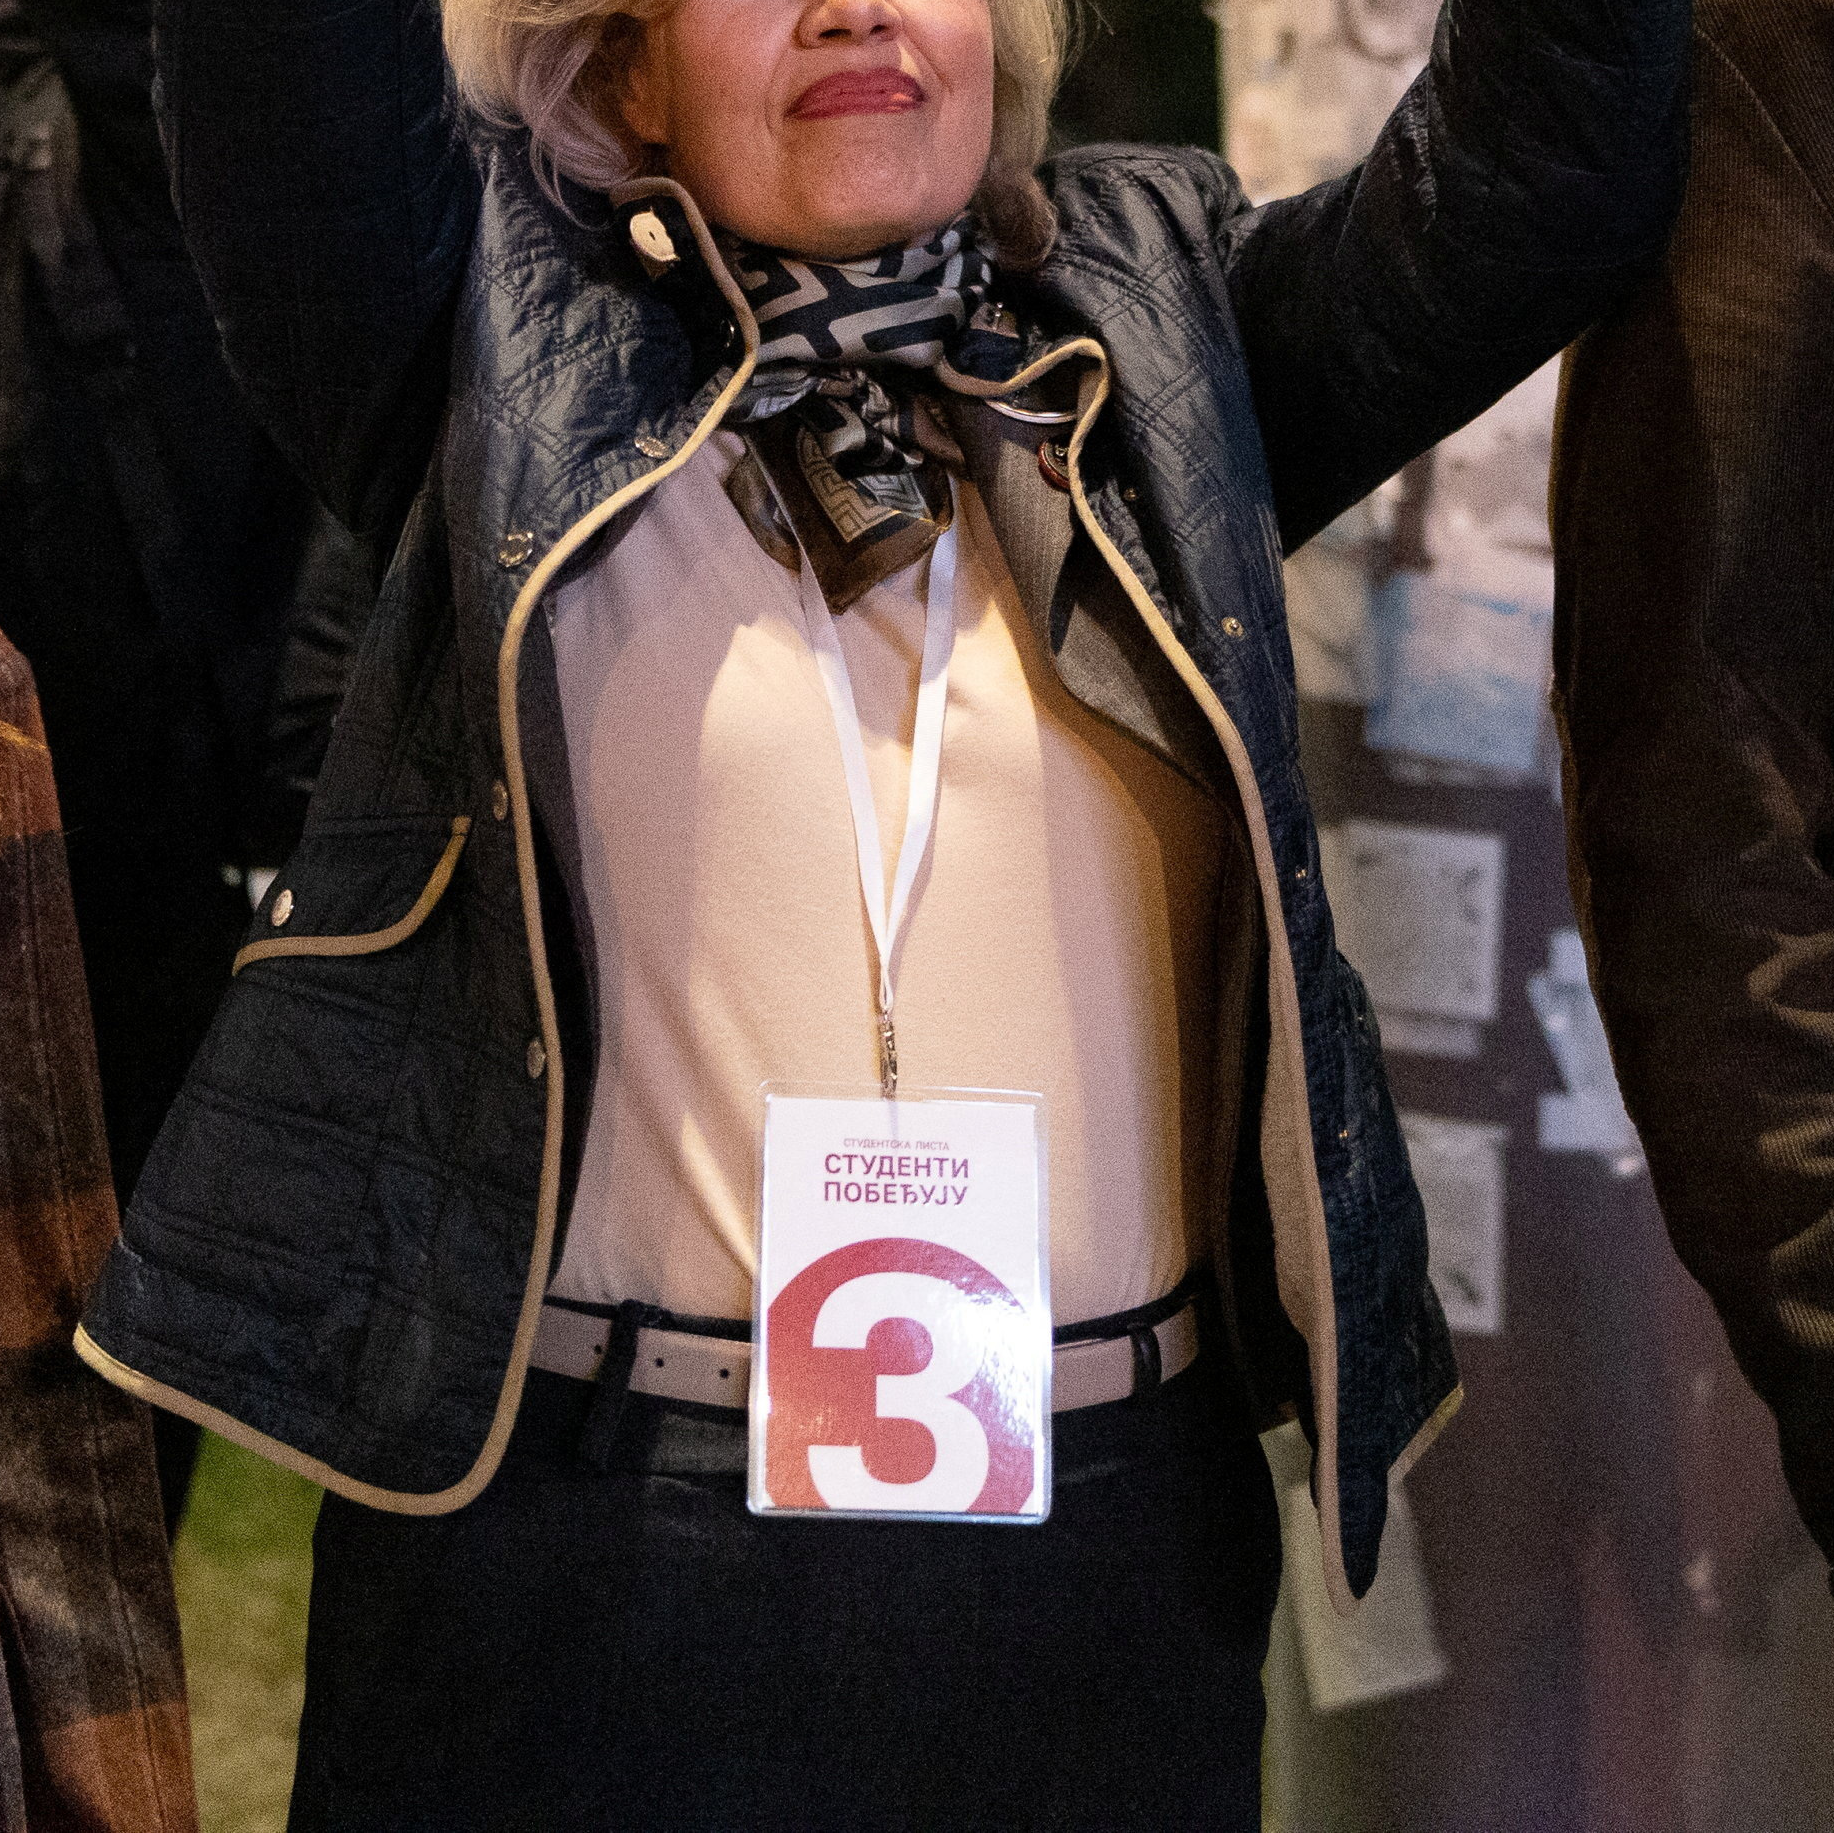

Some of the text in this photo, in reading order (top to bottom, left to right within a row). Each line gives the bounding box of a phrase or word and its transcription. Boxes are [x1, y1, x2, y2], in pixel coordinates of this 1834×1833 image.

[844, 1138, 950, 1151] СТУДЕНТСКА ЛИСТА
[824, 1153, 969, 1179] СТУДЕНТИ
[824, 1181, 968, 1206] ПОБЕЂУЈУ
[807, 1271, 990, 1512] 3
